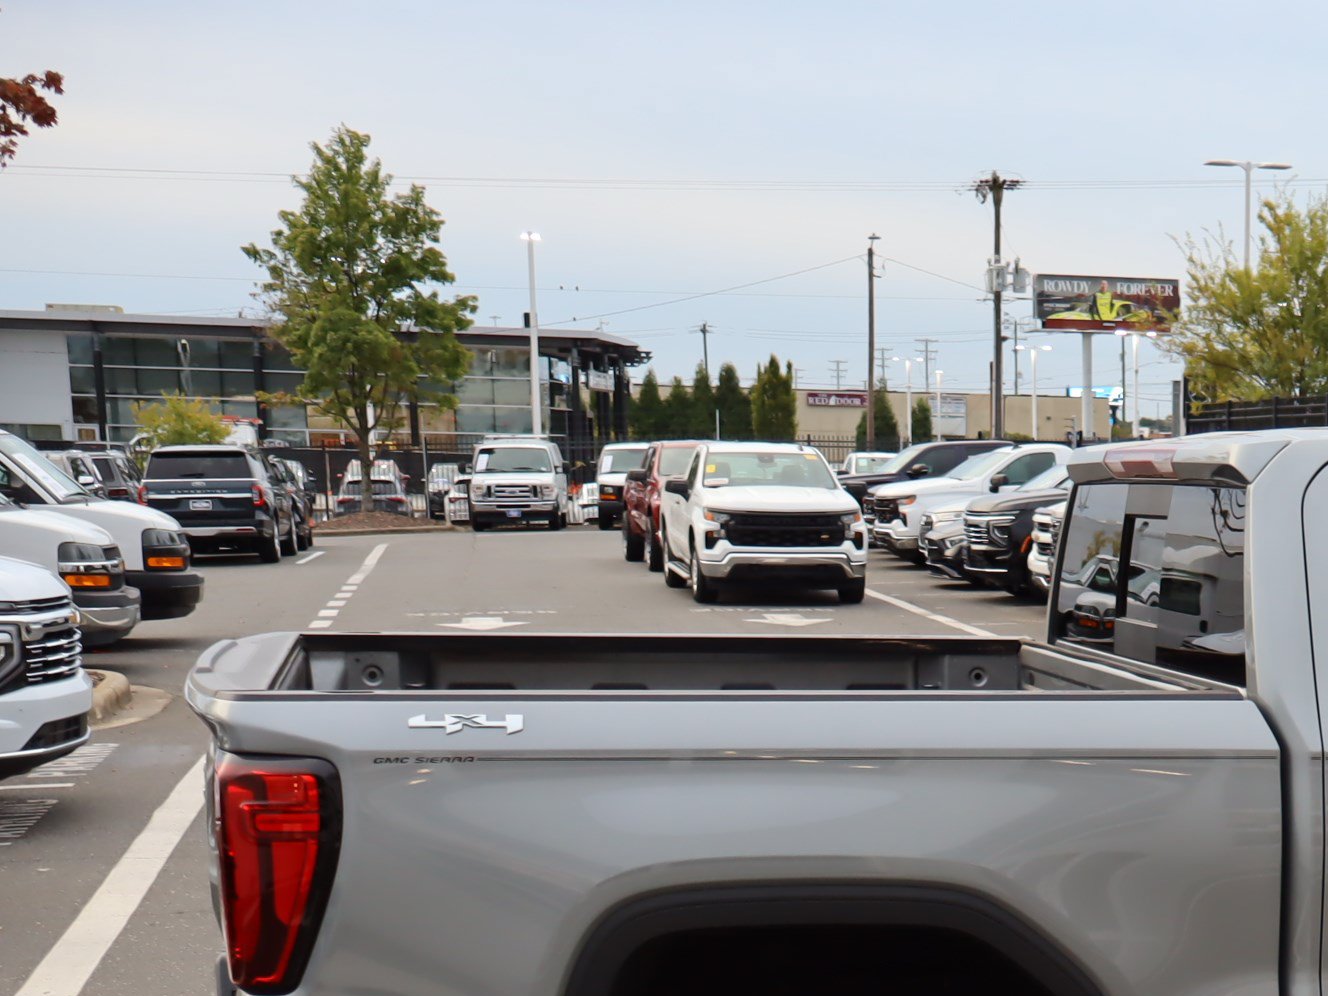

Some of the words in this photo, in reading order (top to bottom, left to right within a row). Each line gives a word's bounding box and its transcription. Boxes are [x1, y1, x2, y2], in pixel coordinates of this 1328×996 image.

[1043, 279, 1091, 294] ROWDY
[1117, 282, 1174, 297] FOREVER
[808, 396, 829, 406] RED
[836, 397, 862, 406] DOOR
[373, 757, 410, 765] GMC
[414, 756, 475, 764] SIERRA
